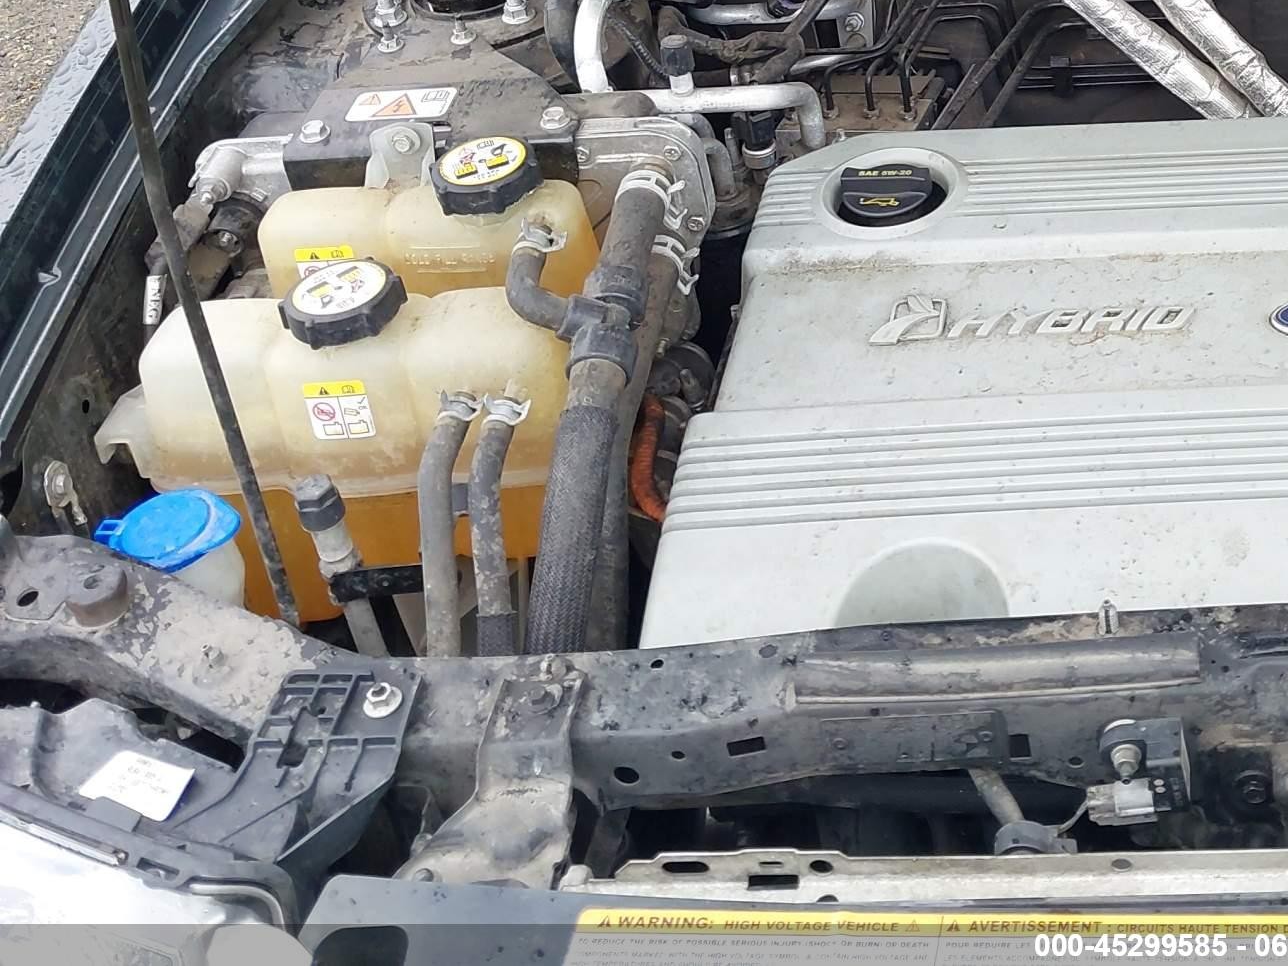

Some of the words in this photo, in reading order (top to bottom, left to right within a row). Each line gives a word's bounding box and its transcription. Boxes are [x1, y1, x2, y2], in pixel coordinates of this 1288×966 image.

[946, 305, 1196, 339] HYBRID
[618, 916, 713, 930] WARNING:
[724, 920, 761, 931] HIGH
[766, 920, 834, 932] VOLTAGE
[837, 921, 900, 933] VEHICLE
[968, 921, 1103, 933] AVERTISSEMENT
[1116, 923, 1175, 934] CIRCUITS
[1179, 923, 1222, 934] HAUTE
[1224, 923, 1280, 934] TENSION
[900, 941, 930, 949] DEATH
